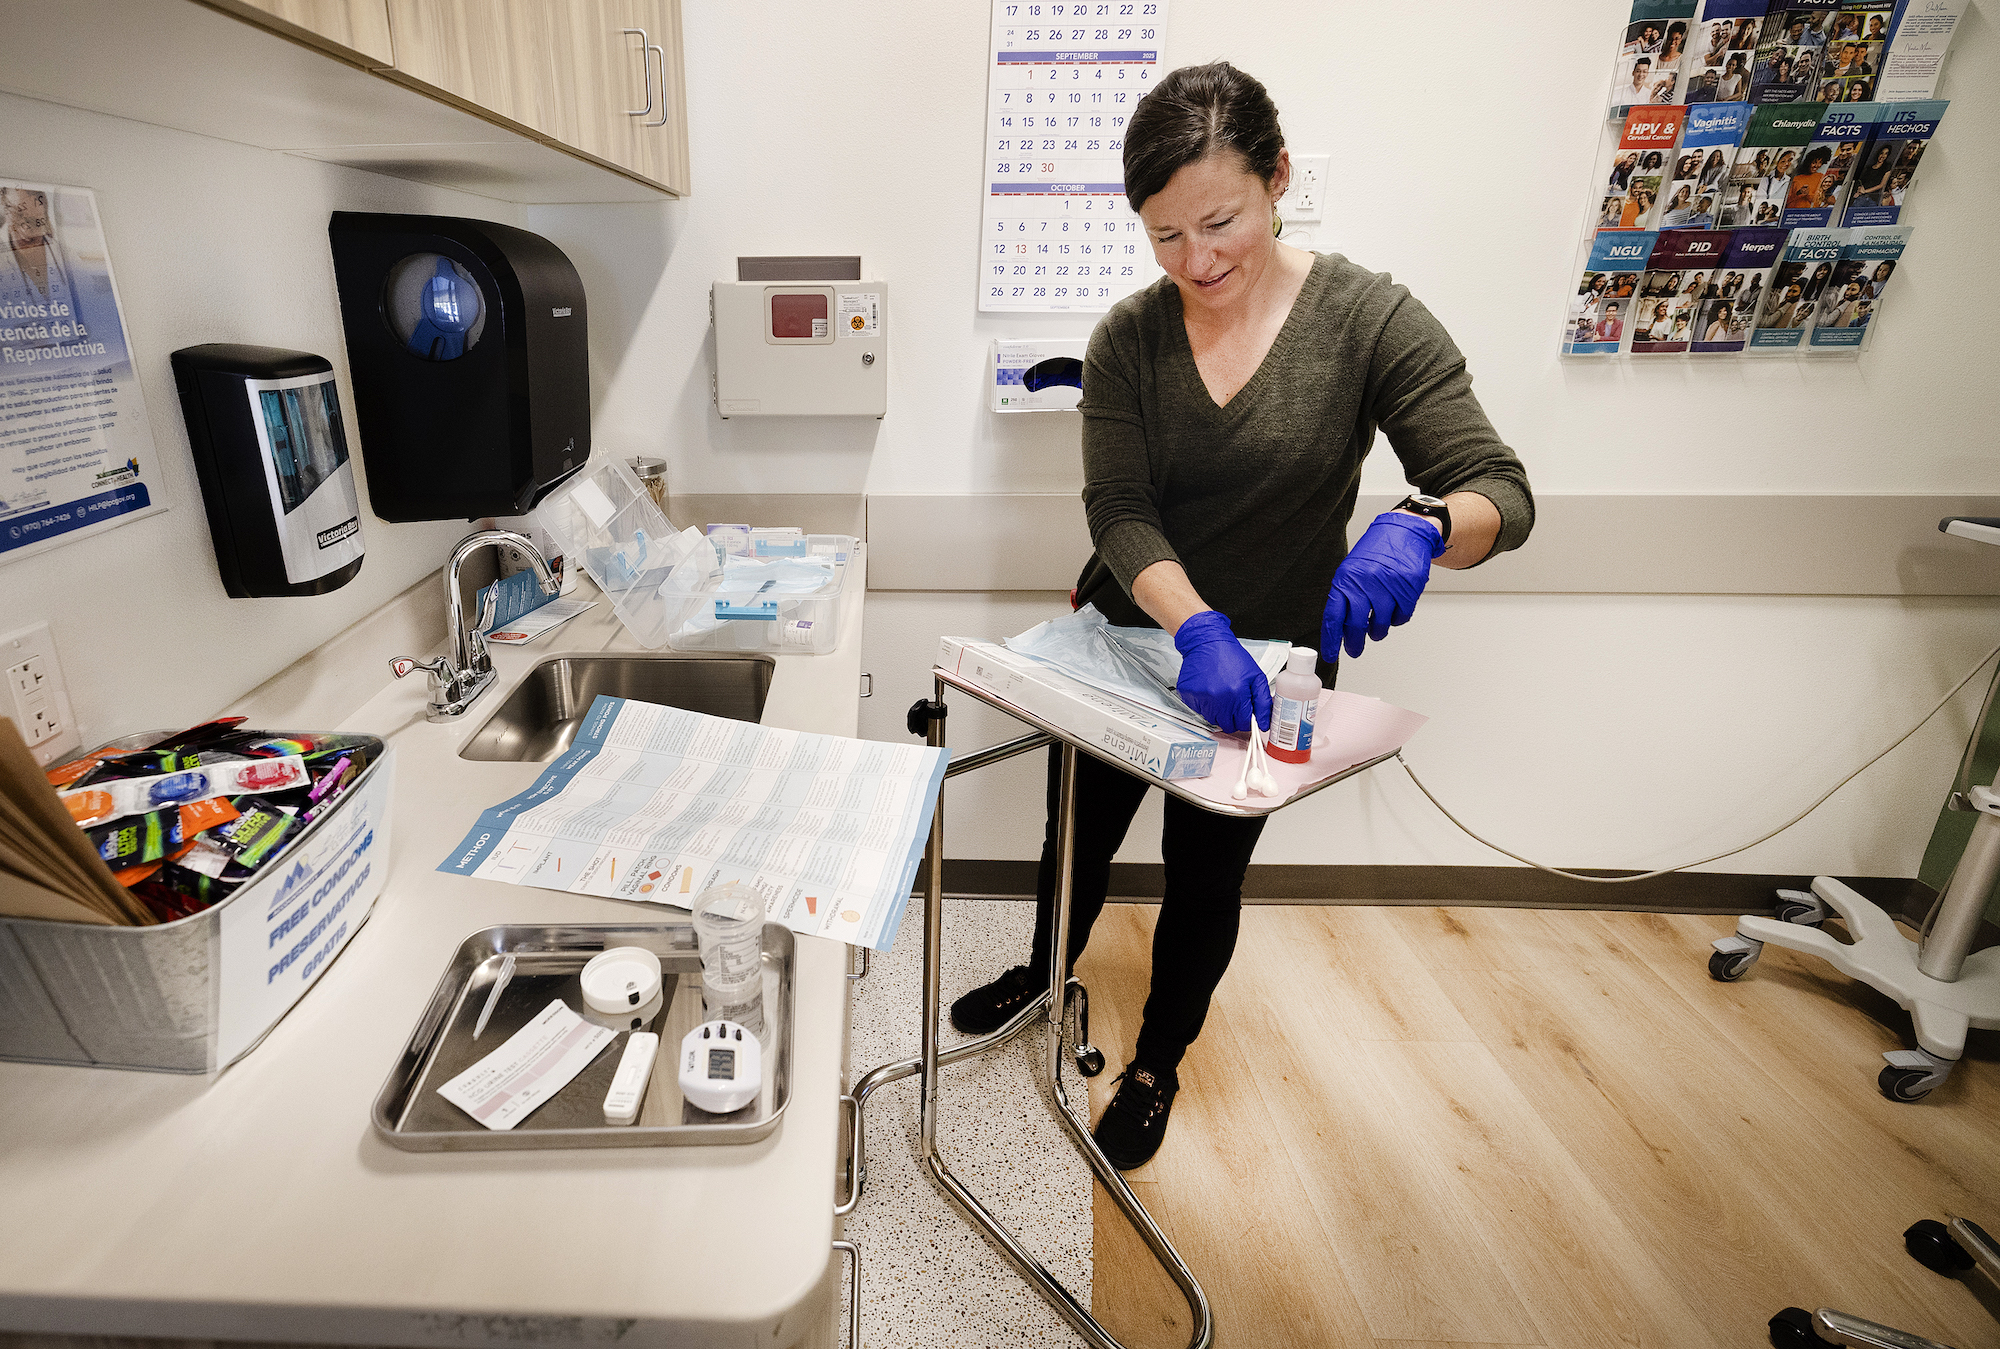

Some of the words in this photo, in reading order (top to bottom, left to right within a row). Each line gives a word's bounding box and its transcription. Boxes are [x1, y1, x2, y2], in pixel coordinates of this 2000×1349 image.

[1006, 6, 1018, 17] 17
[1028, 5, 1041, 16] 18
[1051, 5, 1064, 16] 19
[1073, 5, 1088, 16] 20
[1096, 5, 1109, 16] 21
[1119, 5, 1134, 16] 22
[1142, 4, 1157, 15] 23
[1026, 30, 1040, 41] 25
[1049, 30, 1063, 41] 26
[1071, 30, 1086, 40] 27
[1094, 29, 1109, 40] 28
[1117, 29, 1132, 40] 29
[1140, 29, 1155, 40] 30
[1055, 52, 1098, 60] SEPTEMBER
[1027, 69, 1033, 80] 1
[1049, 70, 1057, 80] 2
[1072, 70, 1080, 80] 3
[1094, 70, 1102, 80] 4
[1118, 69, 1125, 80] 5
[1140, 69, 1148, 80] 6
[1004, 94, 1011, 104] 7
[1026, 93, 1033, 104] 8
[1048, 93, 1056, 104] 9
[1069, 93, 1081, 104] 10
[1092, 93, 1102, 103] 11
[1114, 93, 1126, 103] 12
[1000, 118, 1013, 128] 14
[1023, 117, 1035, 128] 15
[1045, 117, 1057, 127] 16
[1068, 117, 1079, 127] 17
[1090, 117, 1102, 128] 18
[1112, 117, 1125, 127] 19
[1693, 116, 1737, 129] Vaginitis
[1827, 113, 1855, 124] STD
[1894, 111, 1917, 122] ITS
[1629, 123, 1660, 134] HPV
[1664, 122, 1675, 134] &
[1772, 120, 1816, 130] Chlamydia
[1820, 125, 1862, 136] FACTS
[1886, 124, 1930, 134] HECHOS
[998, 140, 1010, 151] 21
[1020, 140, 1034, 150] 22
[1042, 140, 1056, 150] 23
[1064, 140, 1077, 150] 24
[1086, 140, 1100, 150] 25
[1109, 139, 1123, 150] 26
[997, 163, 1011, 173] 28
[1019, 163, 1033, 173] 29
[1041, 163, 1055, 173] 30
[1050, 184, 1086, 192] OCTOBER
[1064, 200, 1069, 210] 1
[1085, 200, 1093, 210] 2
[1107, 200, 1114, 210] 3
[997, 222, 1004, 232] 5
[1018, 222, 1026, 232] 6
[1041, 222, 1047, 232] 7
[1062, 222, 1069, 232] 8
[1084, 222, 1091, 232] 9
[1104, 223, 1116, 232] 10
[1125, 223, 1136, 232] 11
[995, 244, 1006, 254] 12
[1016, 245, 1027, 254] 13
[1036, 245, 1048, 254] 14
[1058, 245, 1070, 255] 15
[1081, 245, 1092, 255] 16
[1103, 245, 1114, 255] 17
[1124, 245, 1135, 255] 18
[1610, 246, 1642, 256] NGU
[1688, 242, 1712, 252] PID
[1741, 242, 1774, 254] Herpes
[1798, 248, 1838, 259] FACTS
[994, 266, 1005, 275] 19
[1013, 266, 1027, 276] 20
[1035, 266, 1046, 276] 21
[1056, 266, 1069, 276] 22
[1077, 266, 1091, 276] 23
[1099, 266, 1112, 276] 24
[1120, 267, 1134, 276] 25
[991, 287, 1004, 297] 26
[1012, 287, 1025, 297] 27
[1033, 287, 1046, 297] 28
[1054, 288, 1068, 297] 29
[1076, 288, 1089, 297] 30
[1097, 288, 1109, 298] 31
[50, 300, 70, 316] de
[51, 320, 71, 338] de
[72, 320, 88, 336] la
[4, 340, 106, 366] Reproductiva
[17, 377, 44, 386] Servicios
[14, 401, 30, 409] salud
[32, 394, 69, 406] reproductiva
[17, 410, 42, 420] importar
[52, 406, 74, 414] estatus
[28, 424, 54, 432] servicios
[98, 411, 118, 419] familiar
[25, 444, 54, 456] planificar
[27, 464, 38, 472] que
[92, 478, 114, 489] CONNECT
[116, 473, 134, 482] HEALTH
[592, 718, 606, 740] STRONG
[604, 701, 616, 720] POINTS
[1103, 733, 1148, 765] Mirena
[1181, 746, 1214, 759] Mirena
[232, 812, 271, 840] ULTRA
[456, 832, 491, 869] METHOD
[491, 850, 502, 862] IUD
[533, 851, 553, 874] IMPLANT
[580, 871, 592, 883] THE
[590, 856, 602, 872] SHOT
[626, 869, 646, 896] VAGINAL
[644, 855, 658, 870] RING
[662, 864, 682, 893] CONDOMS
[269, 899, 310, 950] FREE
[312, 829, 374, 909] CONDOMS
[766, 884, 784, 914] AWARENESS
[784, 888, 804, 920] SPERMICIDE
[268, 861, 372, 986] PRESERVATIVOS
[302, 921, 348, 980] GRATIS
[484, 1072, 504, 1090] URINE
[504, 1061, 518, 1074] TEST
[518, 1034, 548, 1062] CASSETTE
